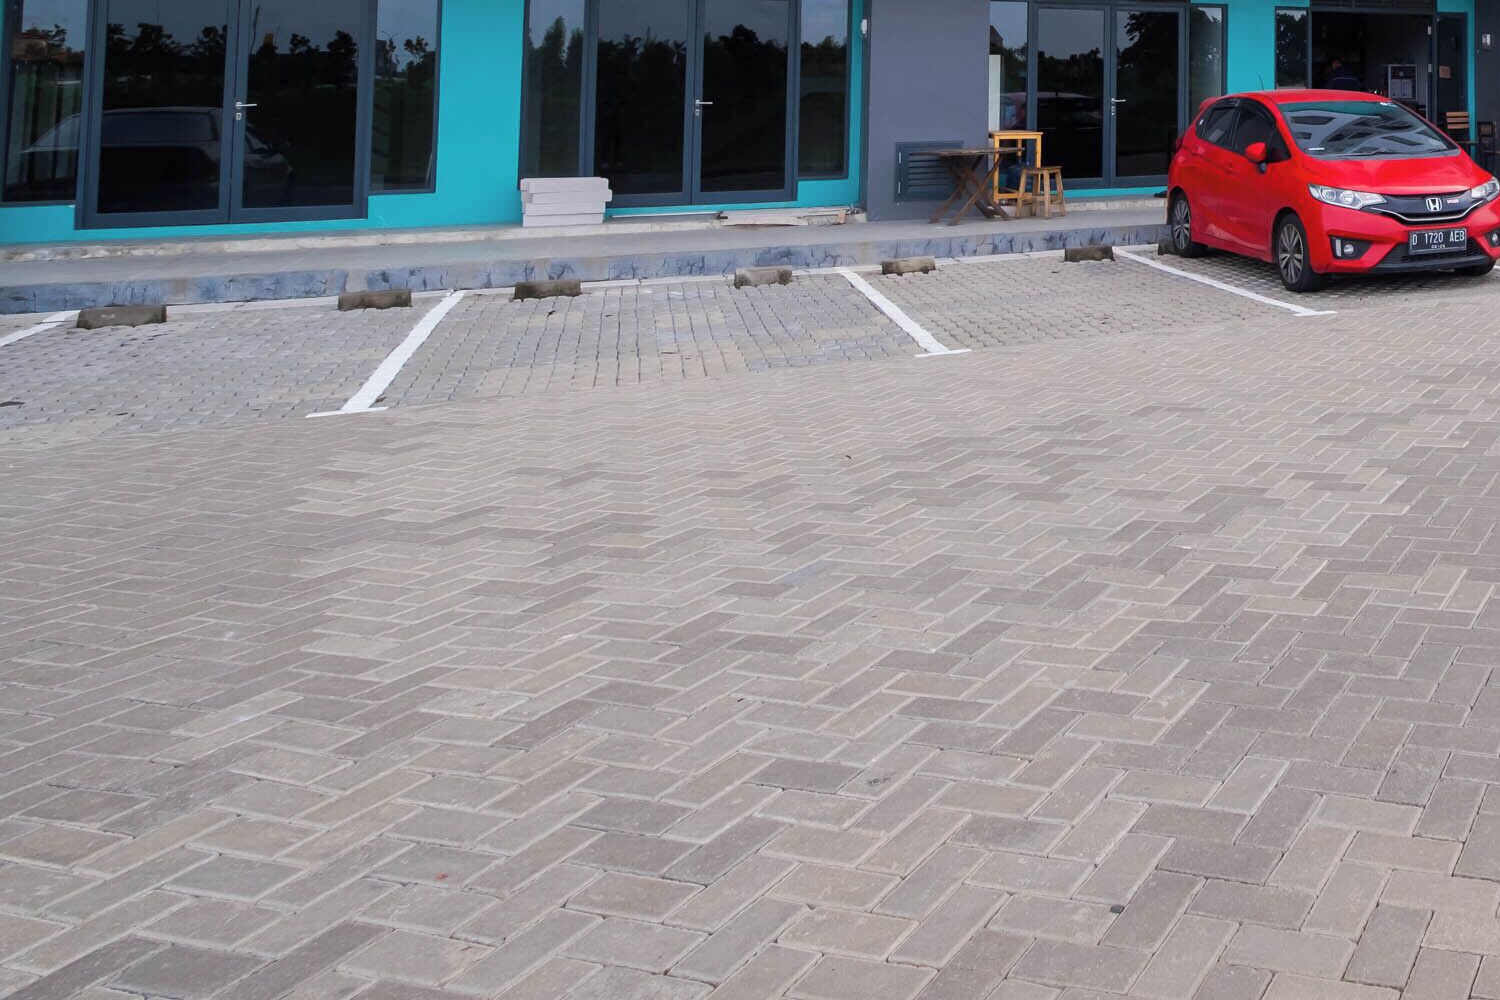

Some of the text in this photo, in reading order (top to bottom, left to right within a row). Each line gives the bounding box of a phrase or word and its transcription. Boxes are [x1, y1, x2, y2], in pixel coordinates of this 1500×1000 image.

[1412, 231, 1464, 245] D 1720 AEB
